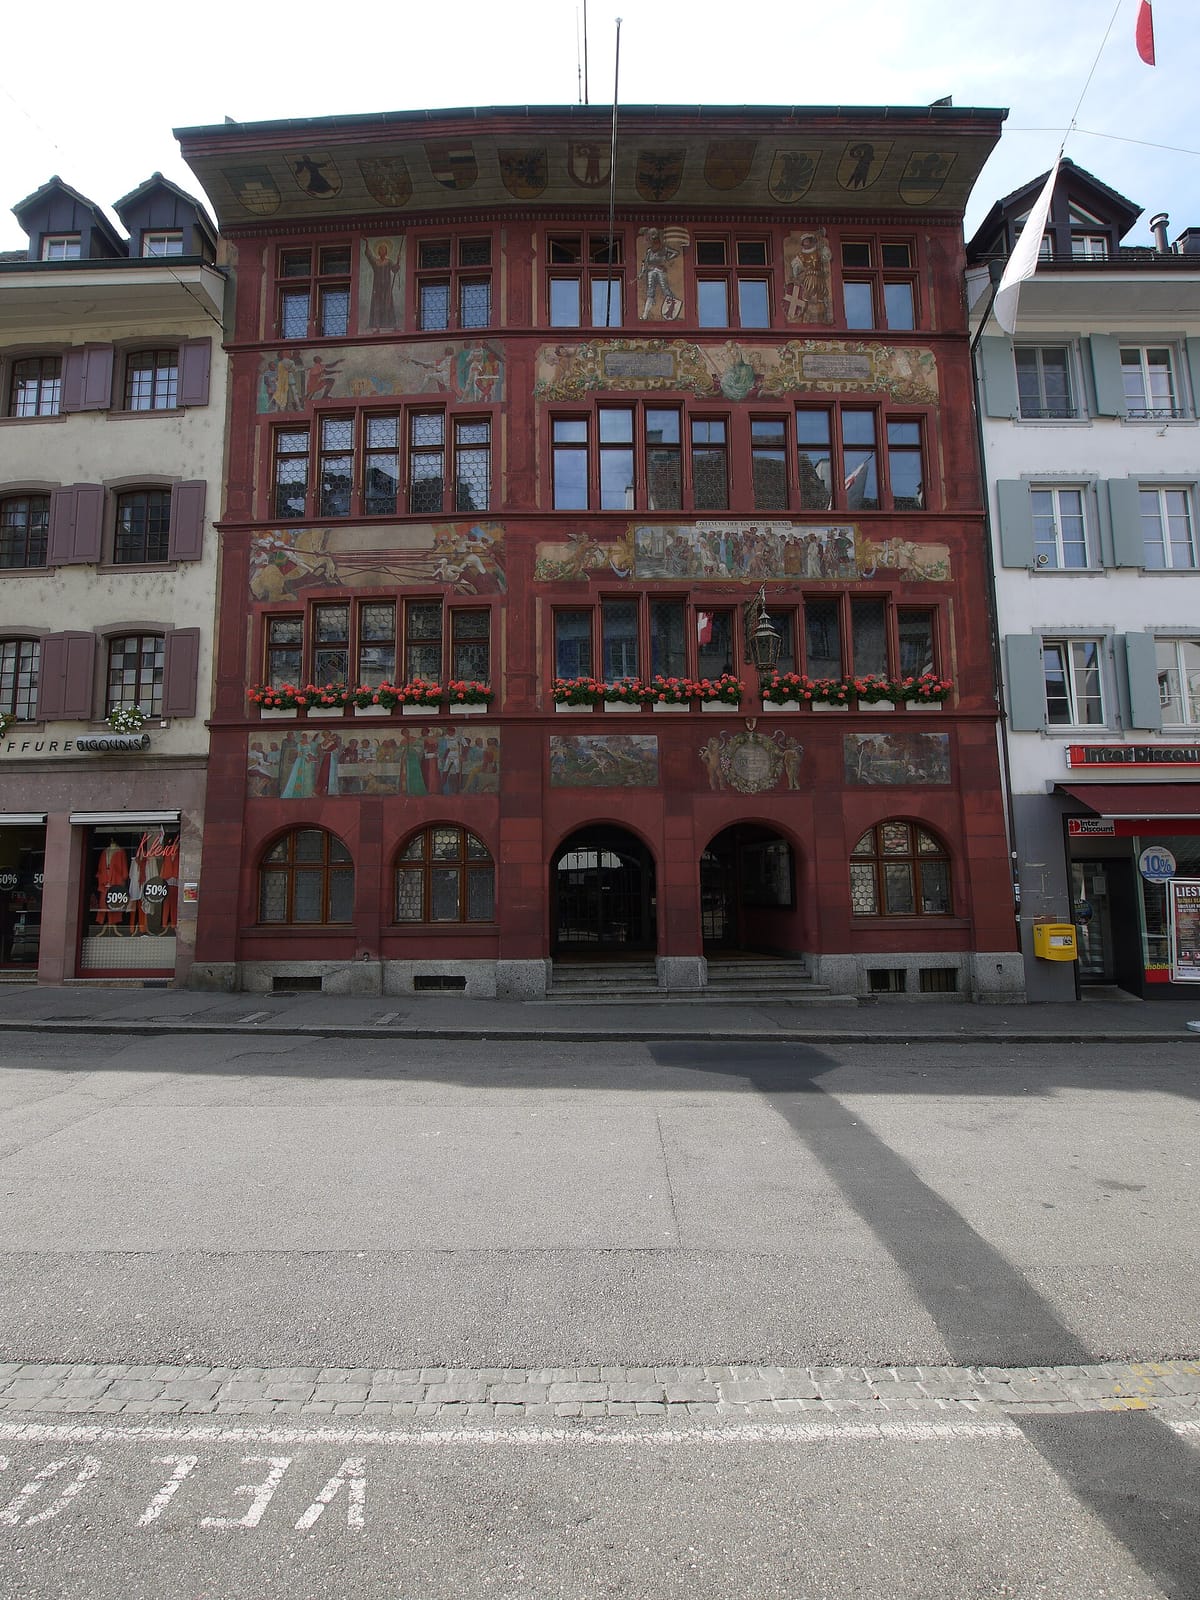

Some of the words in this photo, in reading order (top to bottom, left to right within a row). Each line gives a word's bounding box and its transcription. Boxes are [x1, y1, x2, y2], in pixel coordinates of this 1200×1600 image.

[0, 740, 73, 752] FFURE
[1084, 747, 1133, 763] Inter
[1134, 747, 1200, 763] Discou
[1144, 855, 1172, 873] 10%
[33, 873, 44, 884] 50
[145, 884, 168, 897] 50%
[106, 892, 128, 904] 50%
[0, 1455, 366, 1530] VELO
